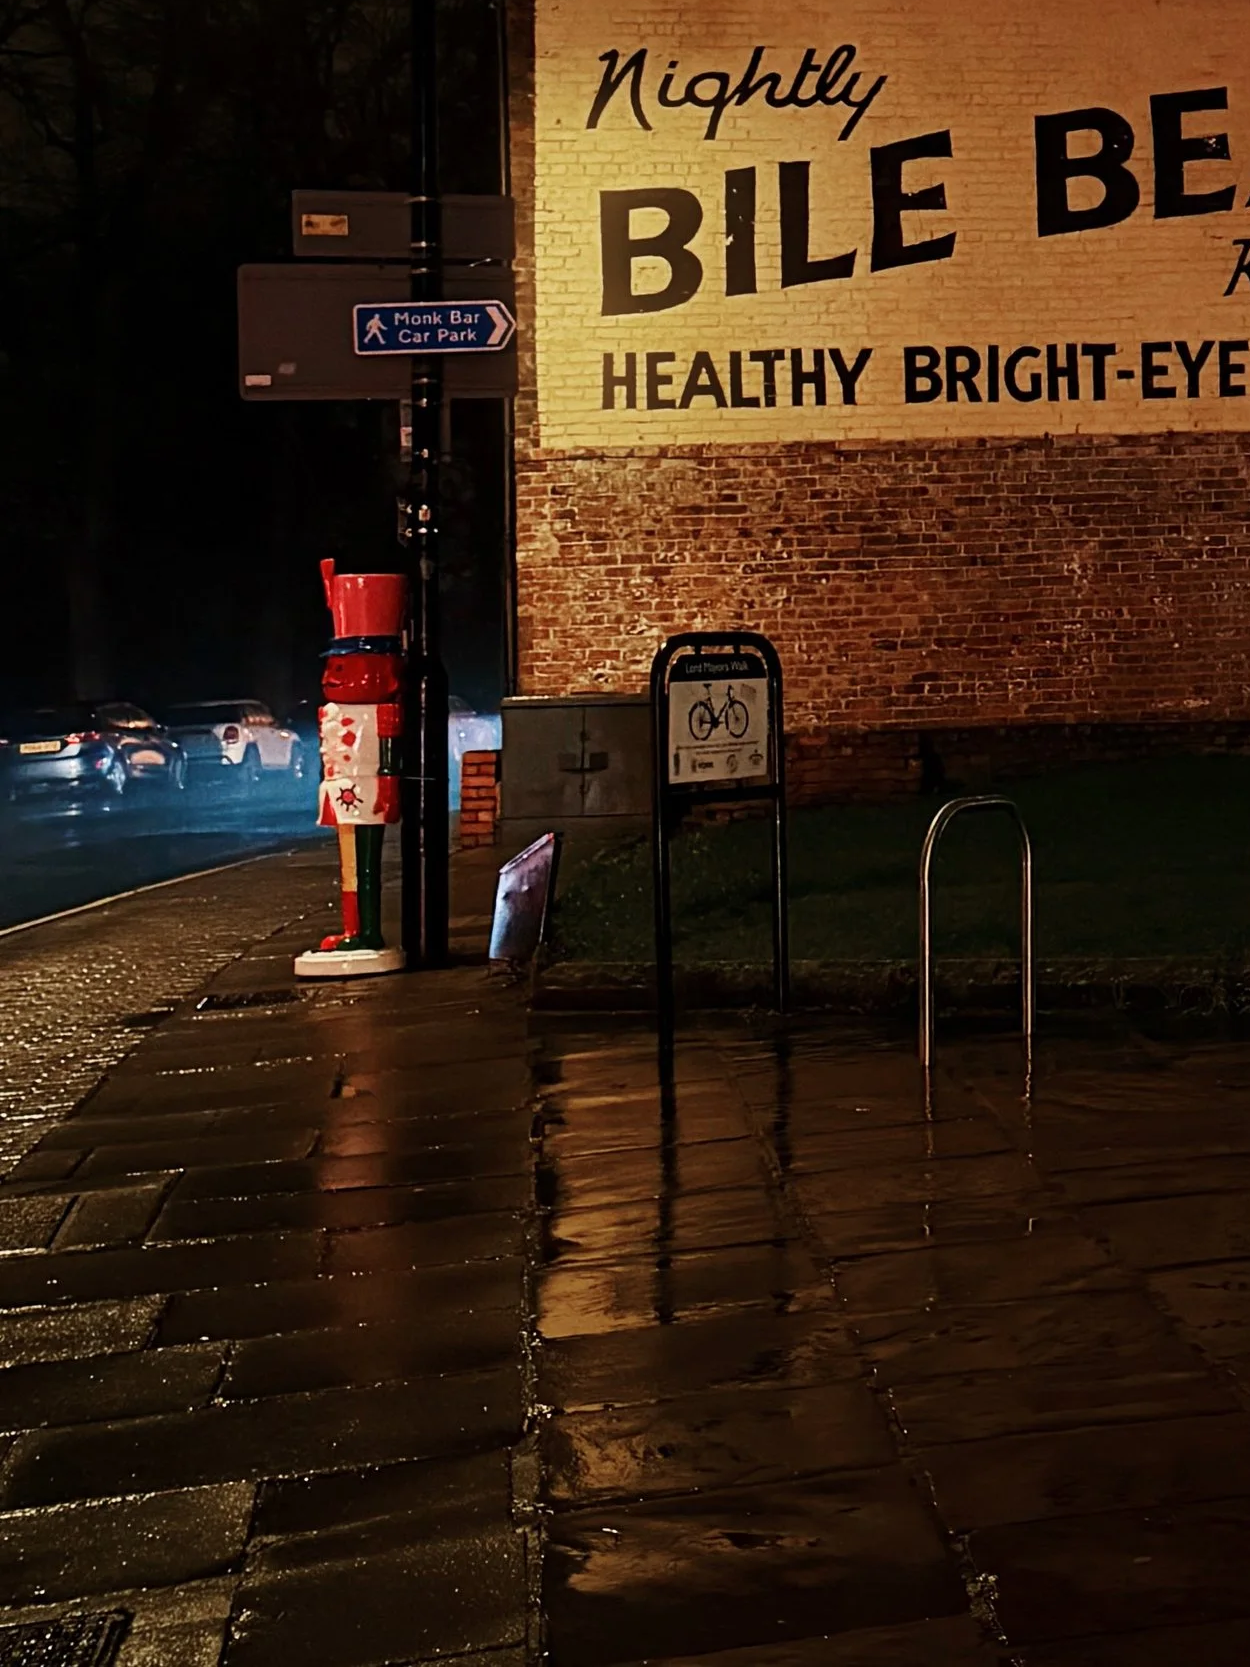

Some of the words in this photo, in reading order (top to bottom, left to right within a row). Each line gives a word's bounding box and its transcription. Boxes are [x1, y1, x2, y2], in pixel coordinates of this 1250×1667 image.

[586, 44, 888, 141] Nightly
[600, 129, 957, 317] BILE
[394, 311, 442, 326] Monk
[450, 310, 480, 325] Bar
[398, 329, 430, 344] Car
[437, 328, 477, 342] Park
[602, 348, 874, 410] HEALTHY
